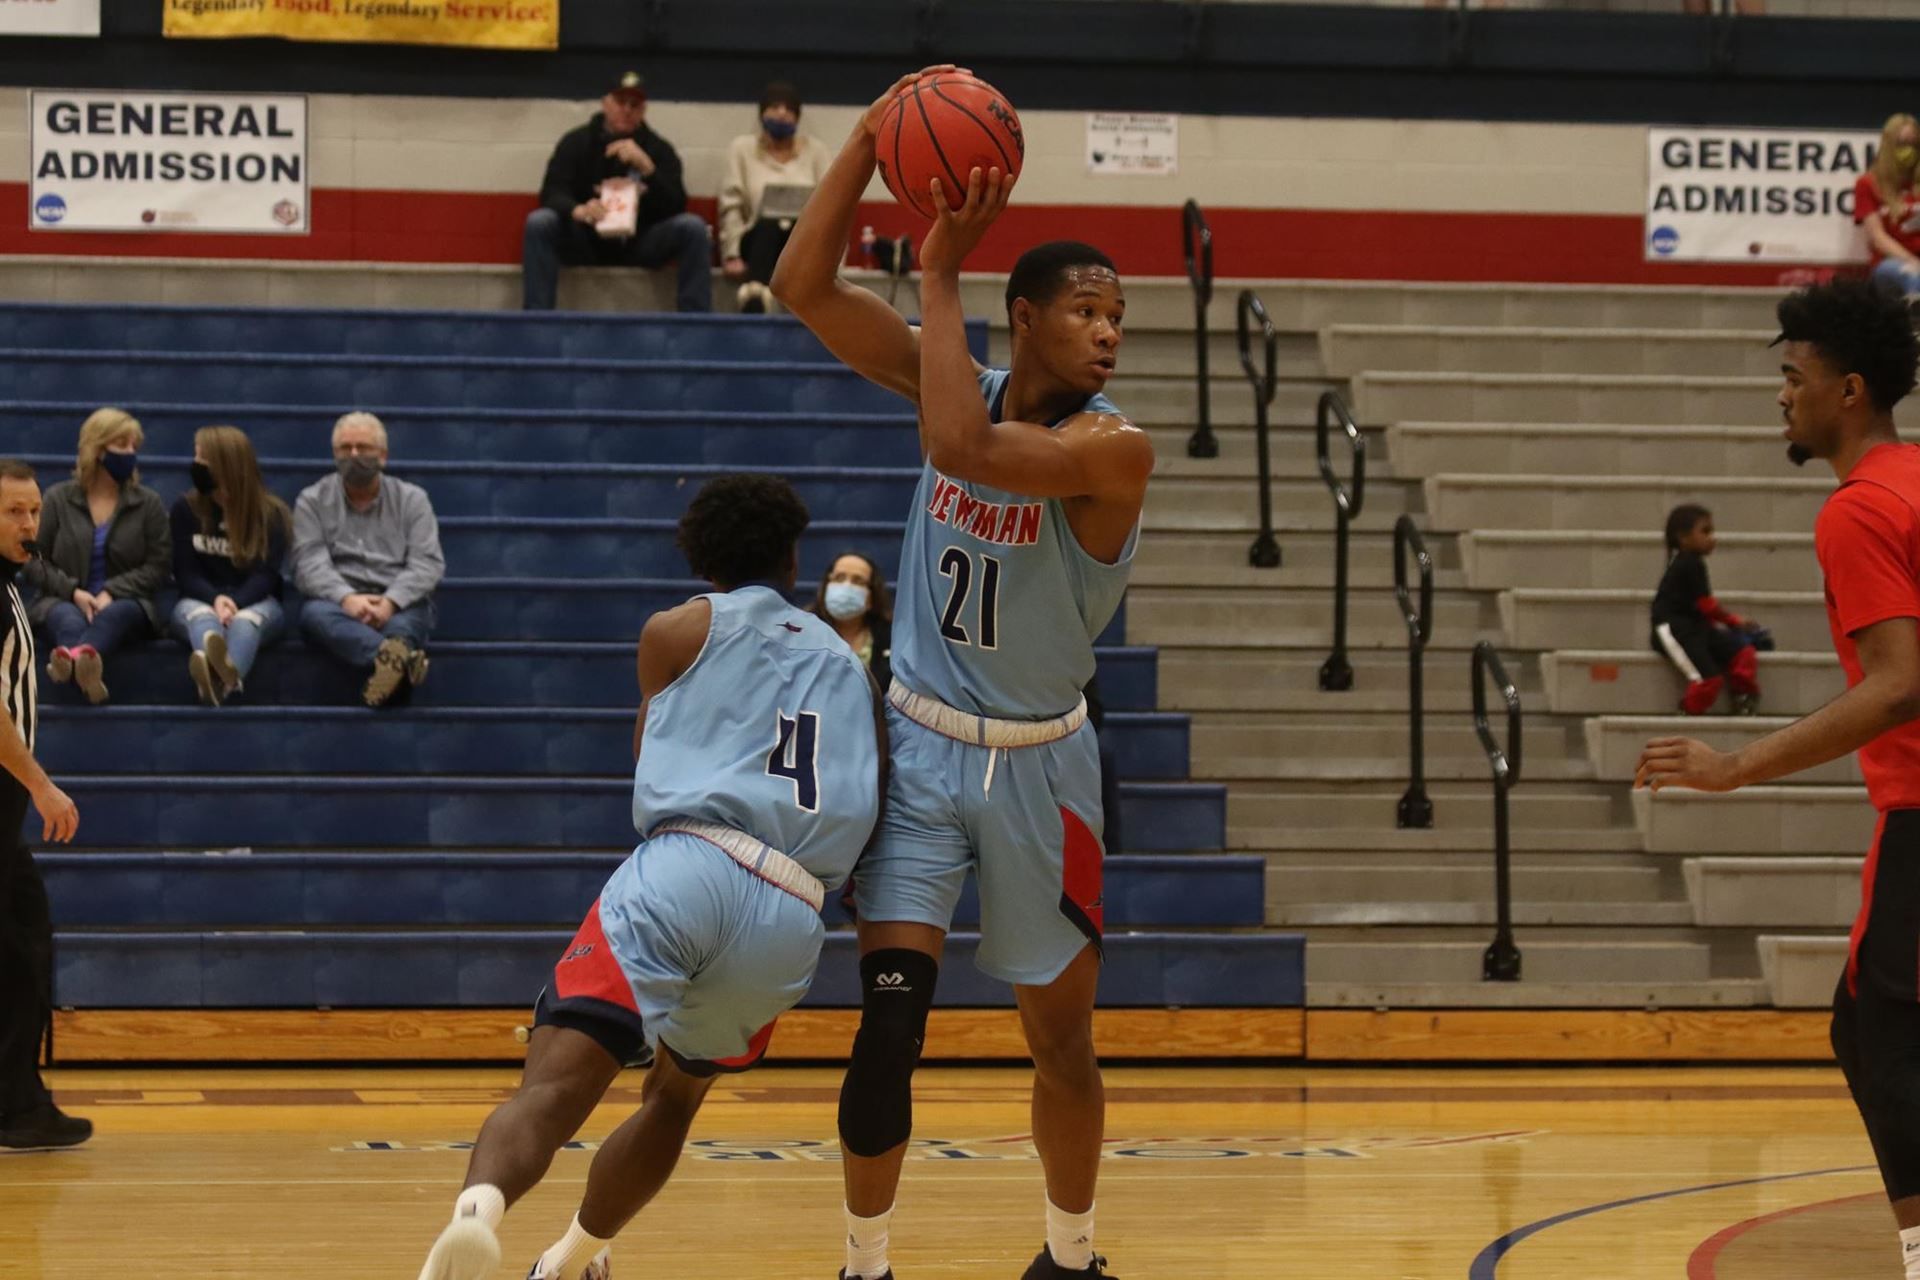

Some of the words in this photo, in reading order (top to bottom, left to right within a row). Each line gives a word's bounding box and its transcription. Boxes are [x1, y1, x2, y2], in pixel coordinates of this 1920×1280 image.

[345, 1, 440, 20] Legendary
[46, 102, 294, 137] GENERAL
[37, 151, 300, 183] ADMISSION
[1653, 184, 1857, 216] ADMISSIO
[938, 545, 1001, 651] 21
[765, 708, 821, 814] 4
[694, 1148, 1373, 1161] POTR
